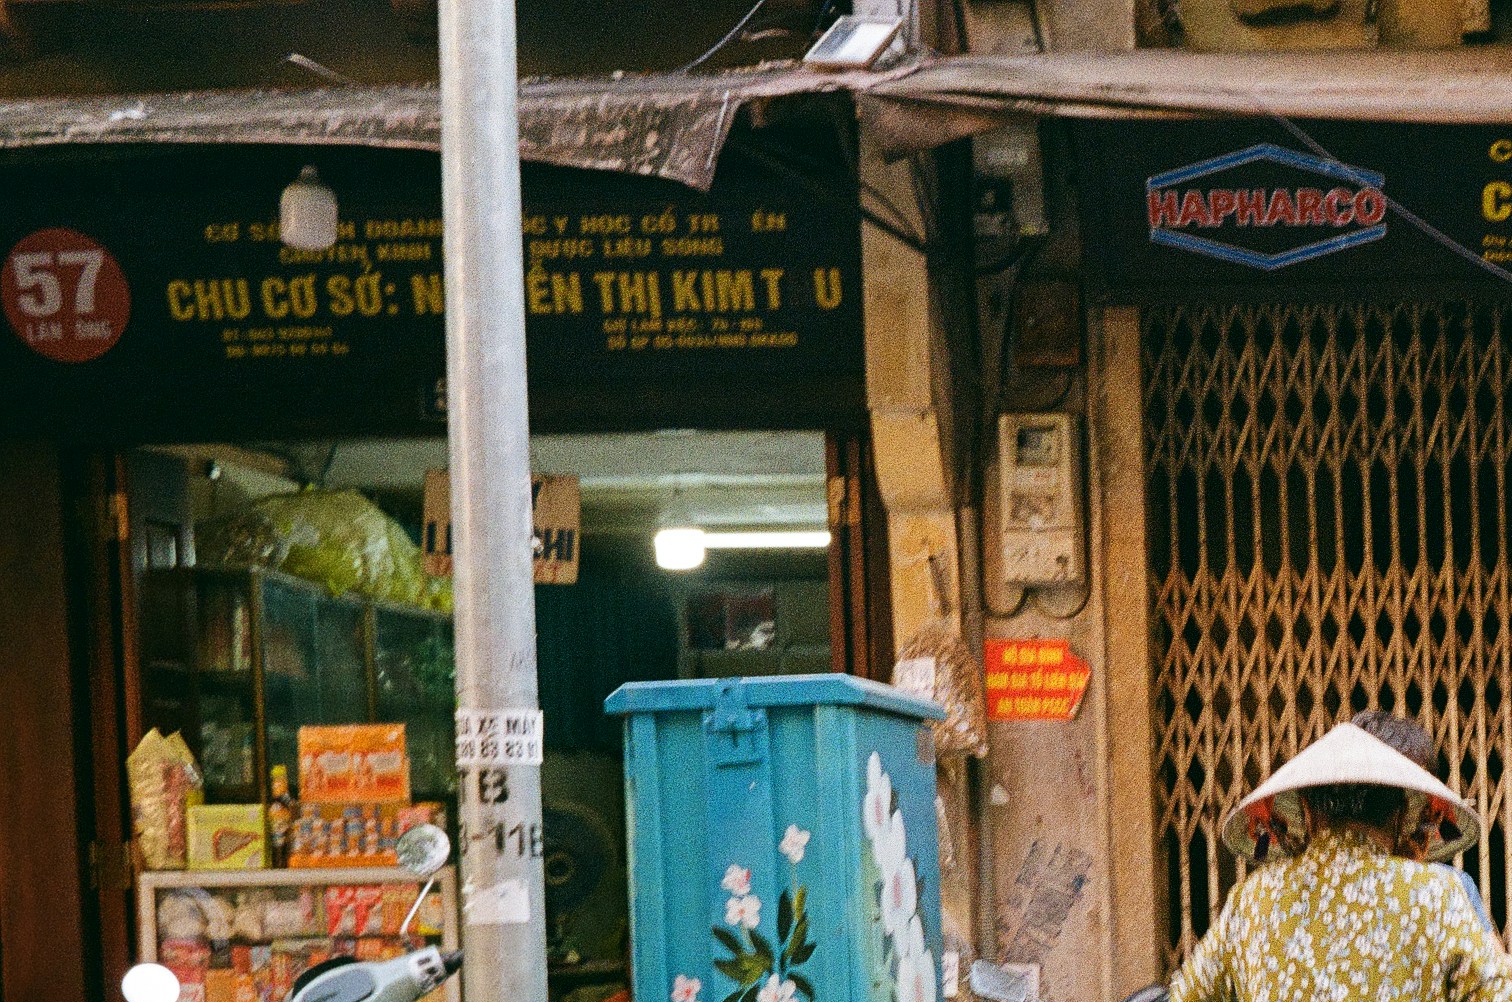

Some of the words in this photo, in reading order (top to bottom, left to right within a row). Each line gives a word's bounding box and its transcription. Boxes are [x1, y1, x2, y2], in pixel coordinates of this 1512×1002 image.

[1148, 185, 1386, 229] HAPHARCO
[13, 250, 103, 317] 57
[261, 273, 317, 319] CƠ
[593, 271, 662, 319] THỊ
[672, 268, 756, 313] KIM
